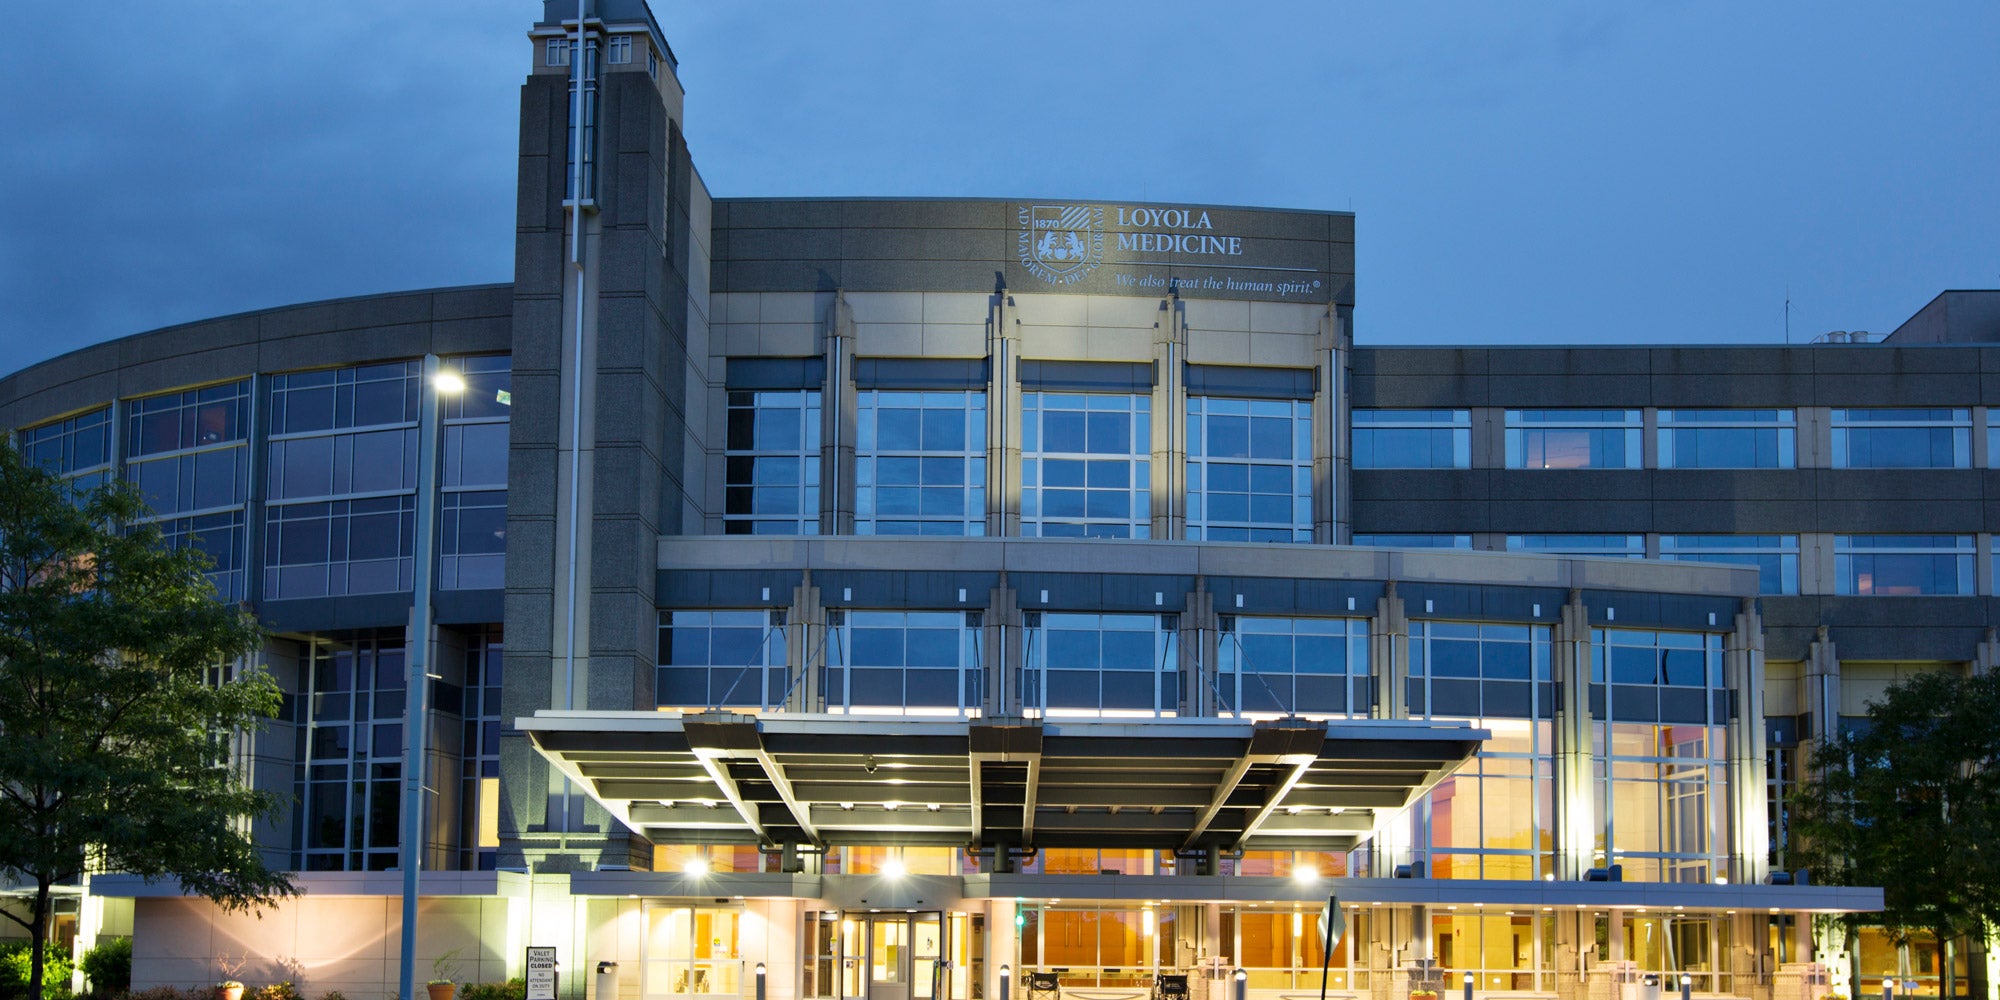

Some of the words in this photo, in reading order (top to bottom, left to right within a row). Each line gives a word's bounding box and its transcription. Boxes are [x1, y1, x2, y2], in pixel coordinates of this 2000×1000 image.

[1018, 206, 1029, 225] AD
[1035, 219, 1060, 229] 1870
[1117, 207, 1213, 230] LOYOLA
[1090, 207, 1104, 268] GLORIAM
[1117, 232, 1243, 255] MEDICINE
[1018, 231, 1057, 285] MAJOREM
[1065, 269, 1088, 285] DEI
[1115, 273, 1136, 287] We
[1139, 273, 1165, 287] also
[1169, 277, 1199, 289] treat
[1203, 275, 1223, 290] the
[1226, 276, 1273, 292] human
